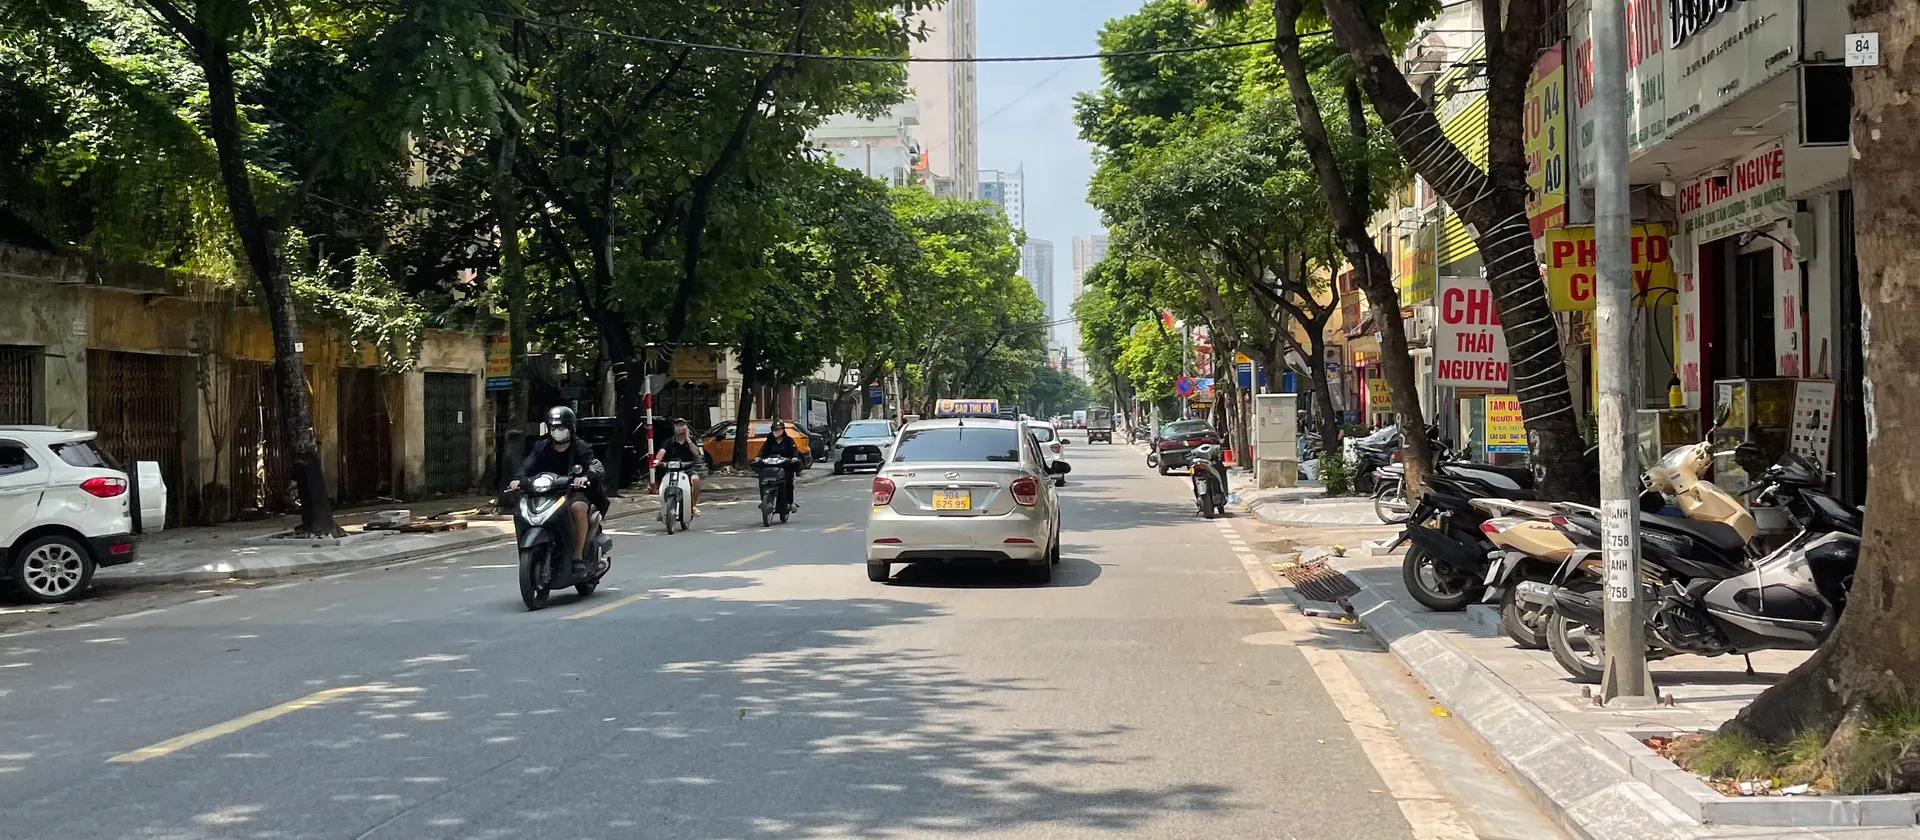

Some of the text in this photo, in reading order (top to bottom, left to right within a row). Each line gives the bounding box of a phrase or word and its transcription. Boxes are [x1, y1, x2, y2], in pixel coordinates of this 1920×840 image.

[1856, 39, 1869, 52] 84
[1543, 80, 1560, 123] A4
[1680, 177, 1701, 215] CHÈ
[1456, 329, 1494, 353] THÁI
[1438, 358, 1509, 382] NGUYÊN
[936, 500, 967, 509] 625.95
[943, 491, 960, 500] 30A
